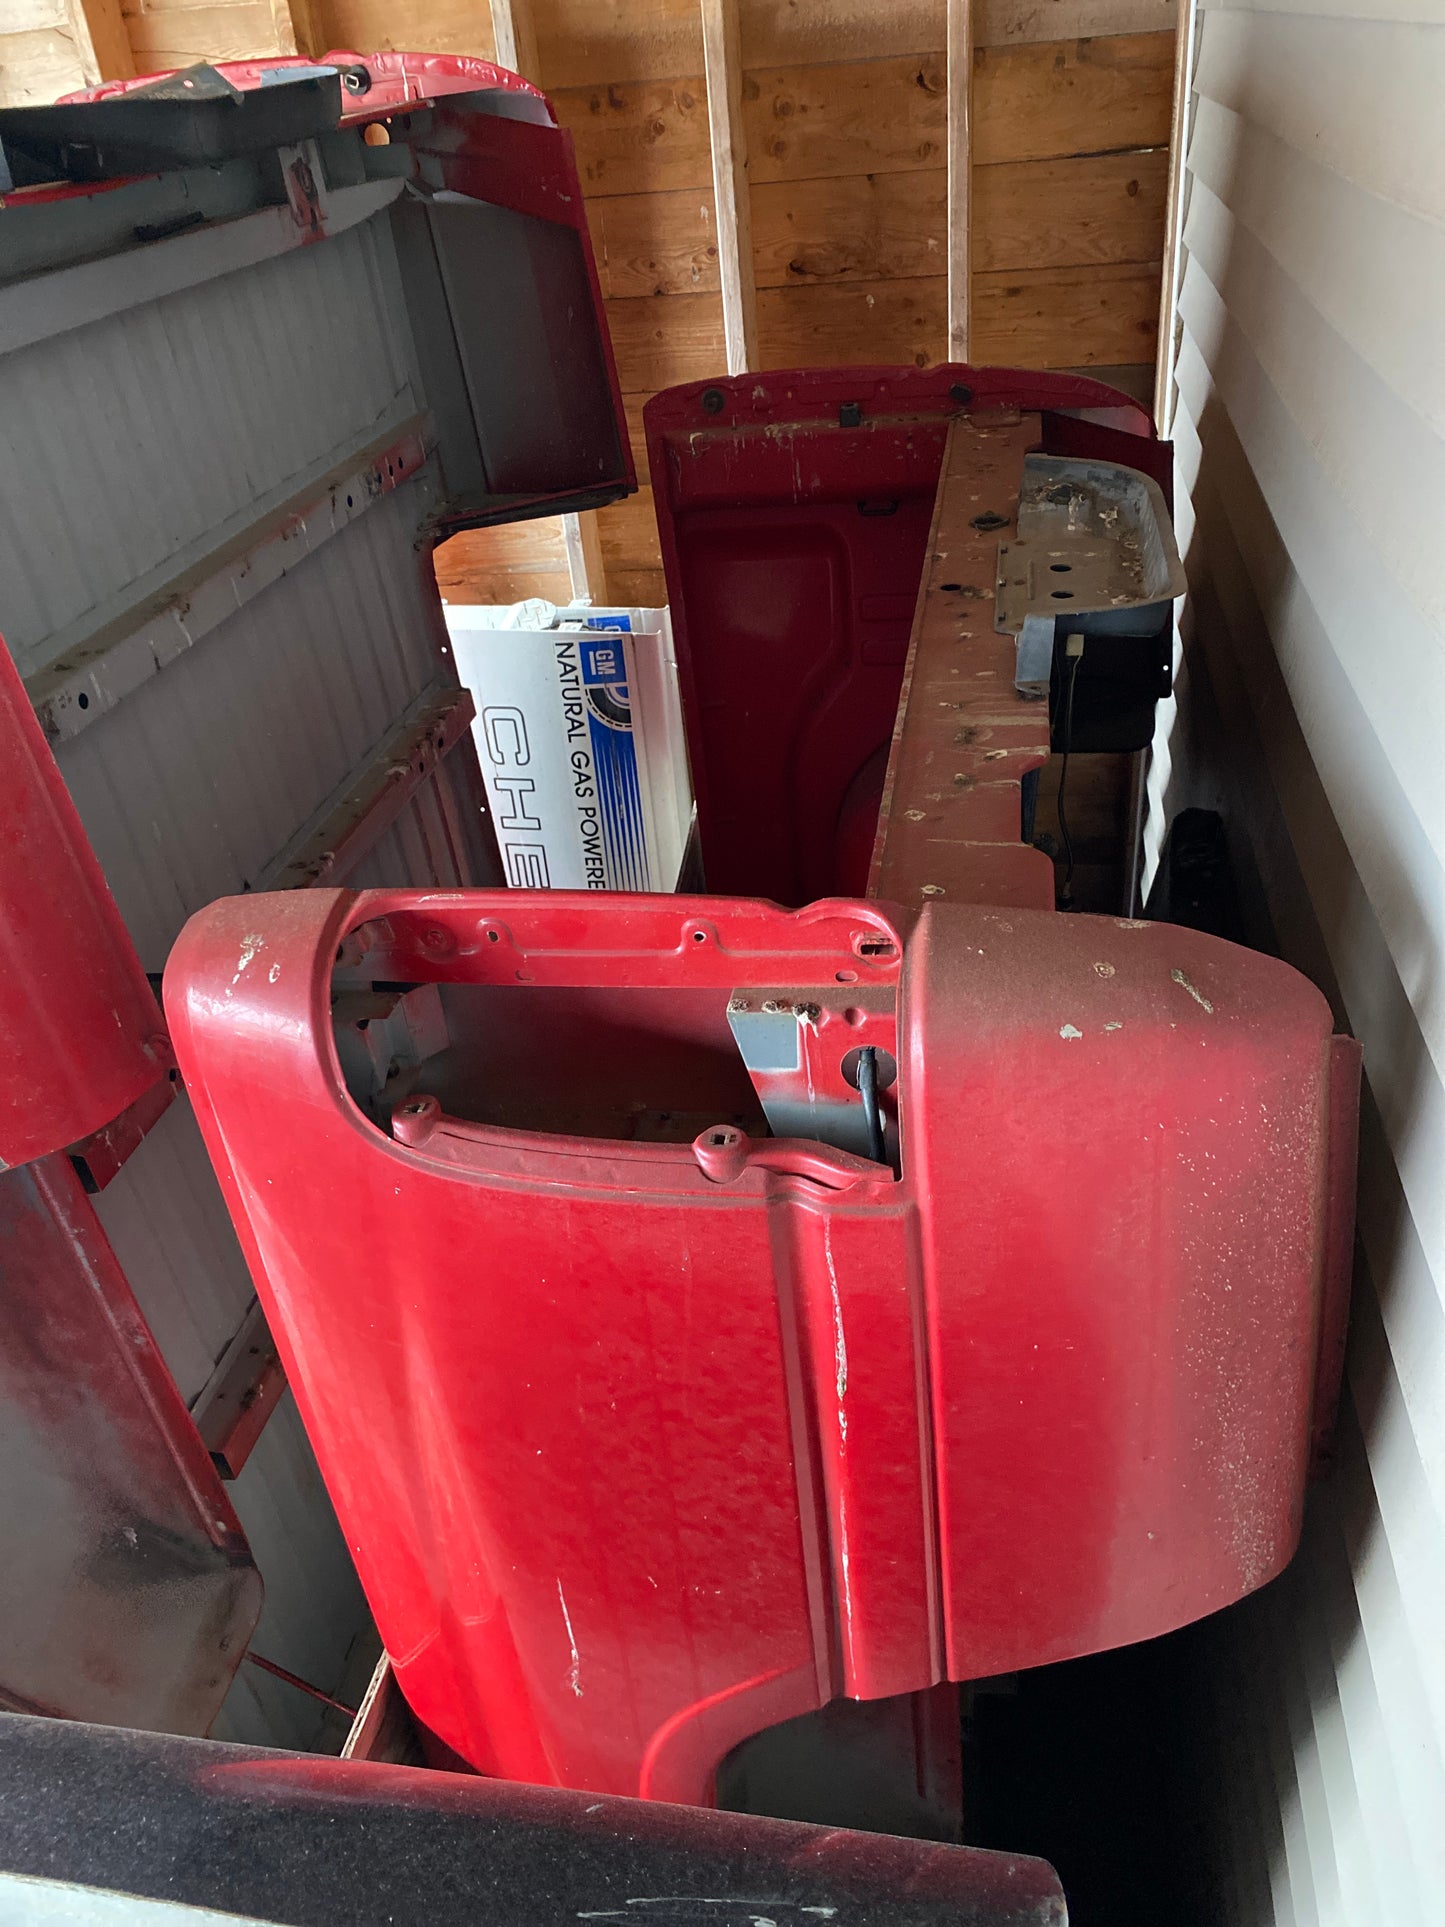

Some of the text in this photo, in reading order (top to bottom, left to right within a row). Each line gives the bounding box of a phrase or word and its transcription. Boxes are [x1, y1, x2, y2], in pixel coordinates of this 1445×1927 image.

[595, 649, 616, 675] GM
[555, 642, 587, 743] NATURAL
[571, 751, 594, 798] GAS
